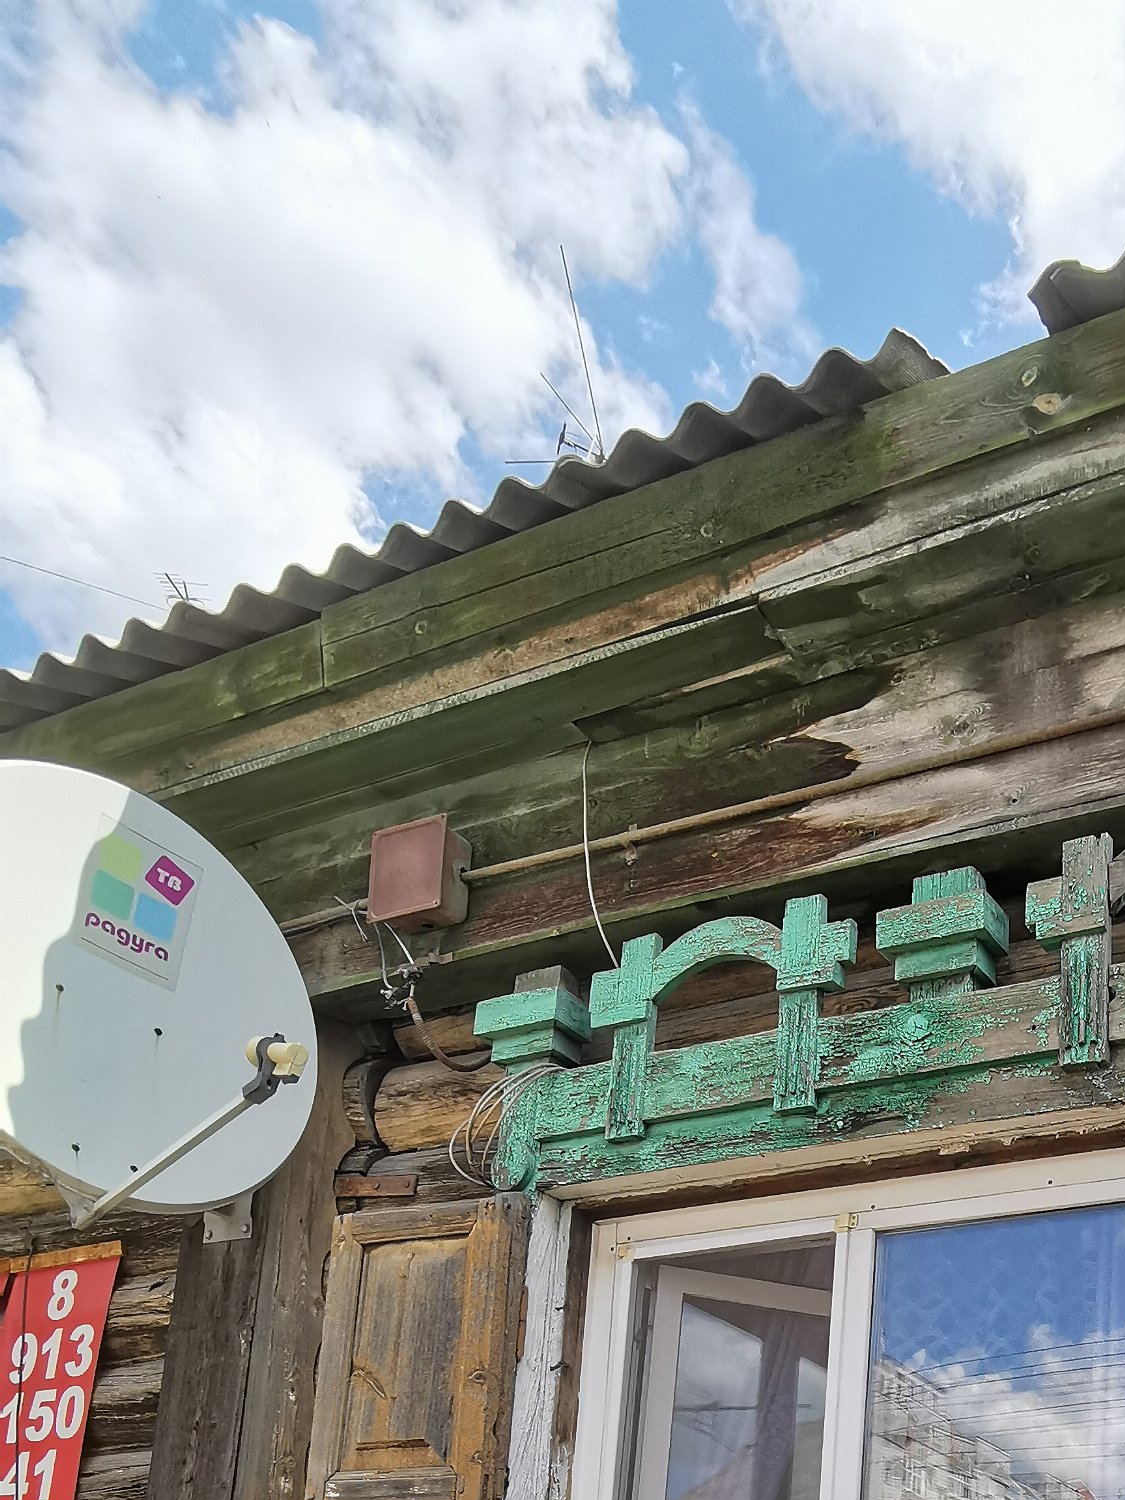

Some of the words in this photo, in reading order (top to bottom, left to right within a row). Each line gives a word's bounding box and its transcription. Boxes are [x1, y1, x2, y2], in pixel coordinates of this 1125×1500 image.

[47, 1269, 78, 1321] 8
[9, 1324, 95, 1384] 913
[0, 1385, 85, 1445] 150
